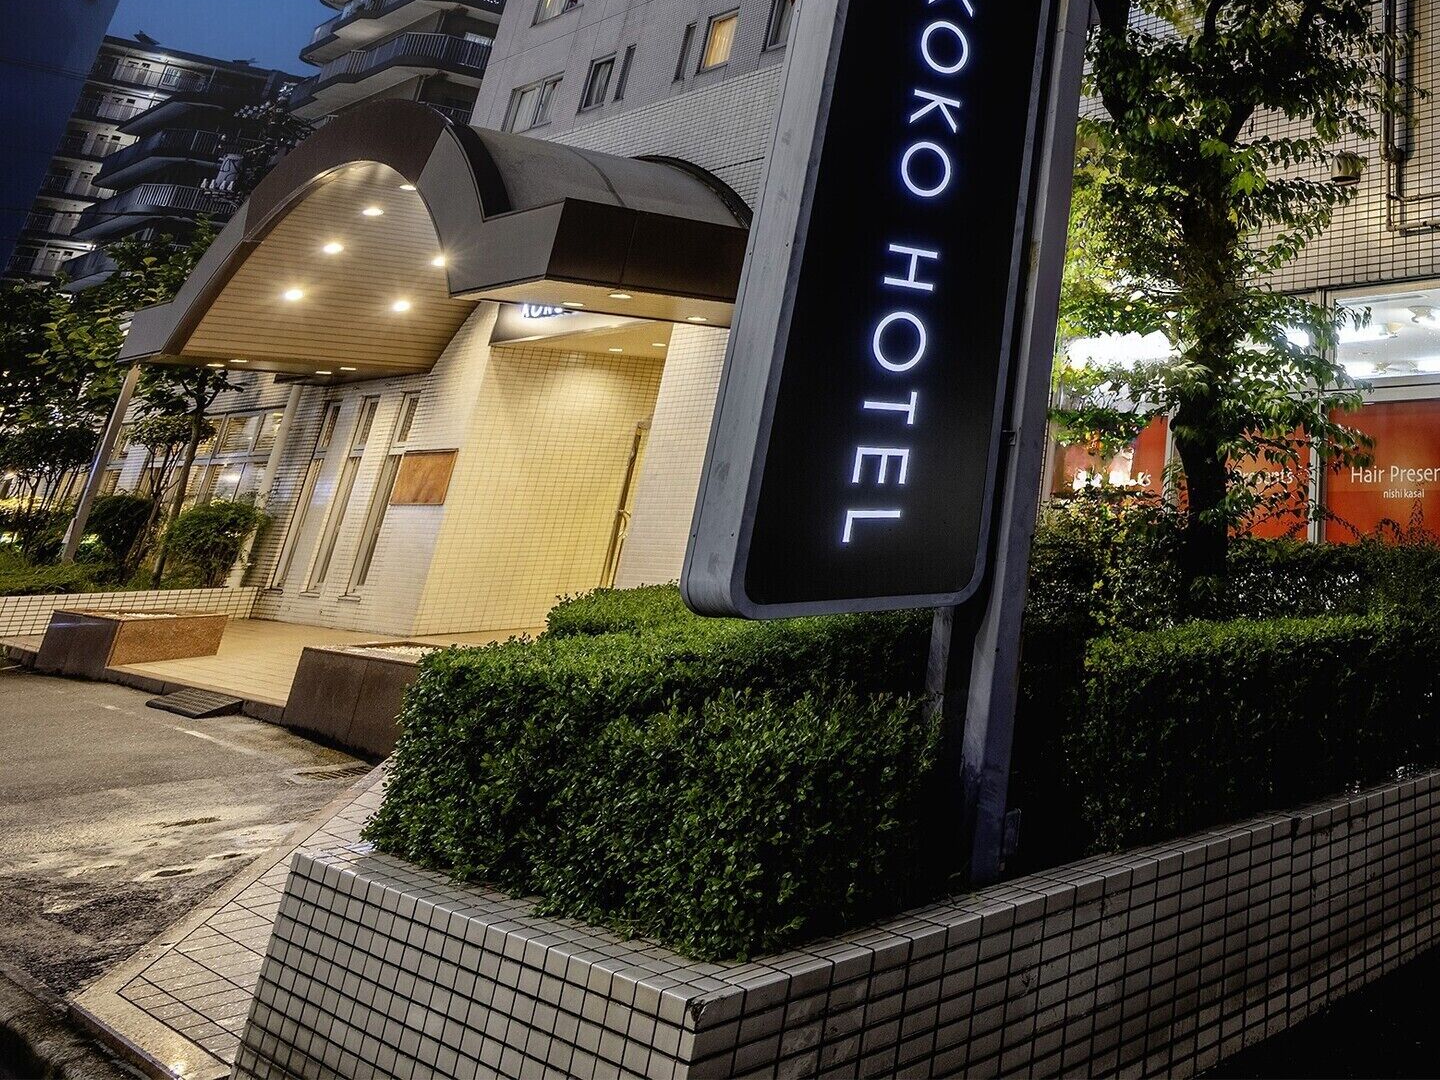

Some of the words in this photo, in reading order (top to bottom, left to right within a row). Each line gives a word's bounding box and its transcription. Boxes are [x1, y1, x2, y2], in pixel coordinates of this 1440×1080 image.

[842, 243, 938, 543] HOTEL
[1351, 466, 1385, 483] Hair
[1383, 489, 1403, 499] nishi
[1403, 488, 1425, 498] kasai
